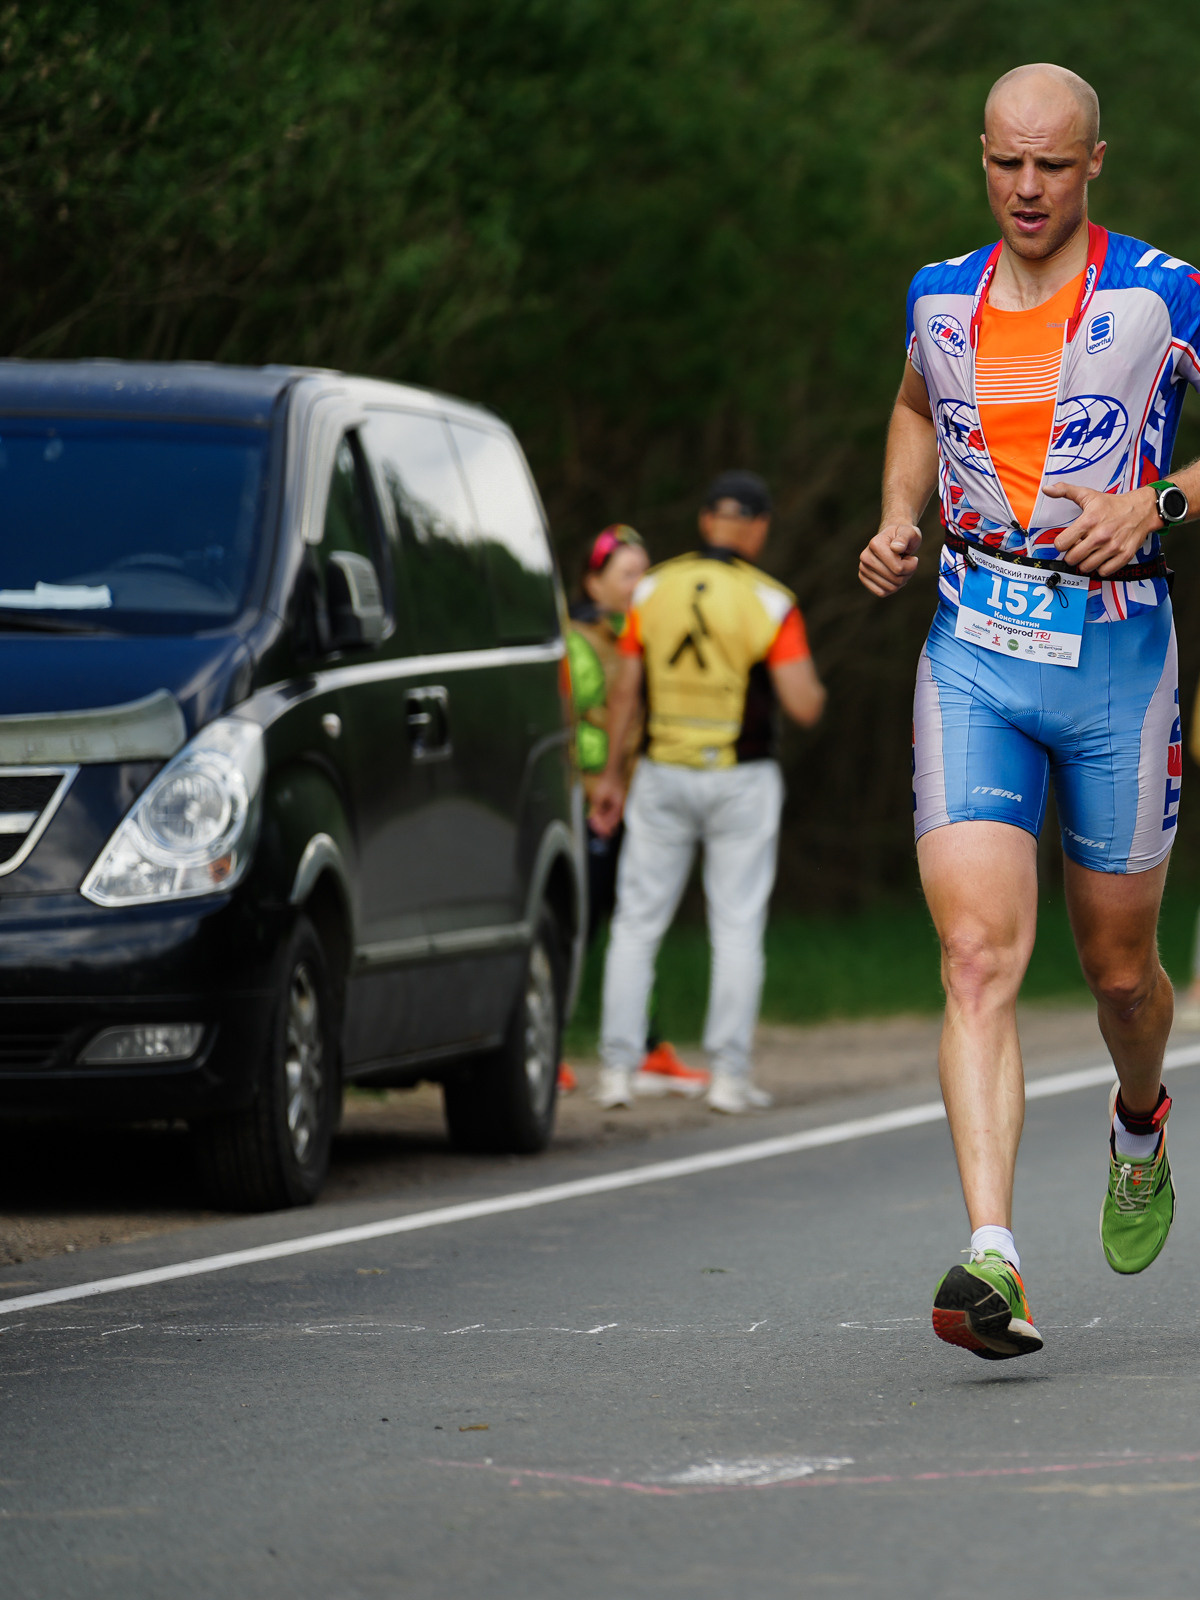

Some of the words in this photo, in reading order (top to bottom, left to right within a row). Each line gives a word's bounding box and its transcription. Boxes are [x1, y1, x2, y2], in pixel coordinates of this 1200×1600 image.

[931, 320, 965, 351] ITERA
[1088, 337, 1112, 351] sportful
[1023, 572, 1062, 585] ТРИАТ
[986, 573, 1054, 621] 152
[993, 610, 1040, 628] Константин
[971, 786, 1023, 803] ITERA
